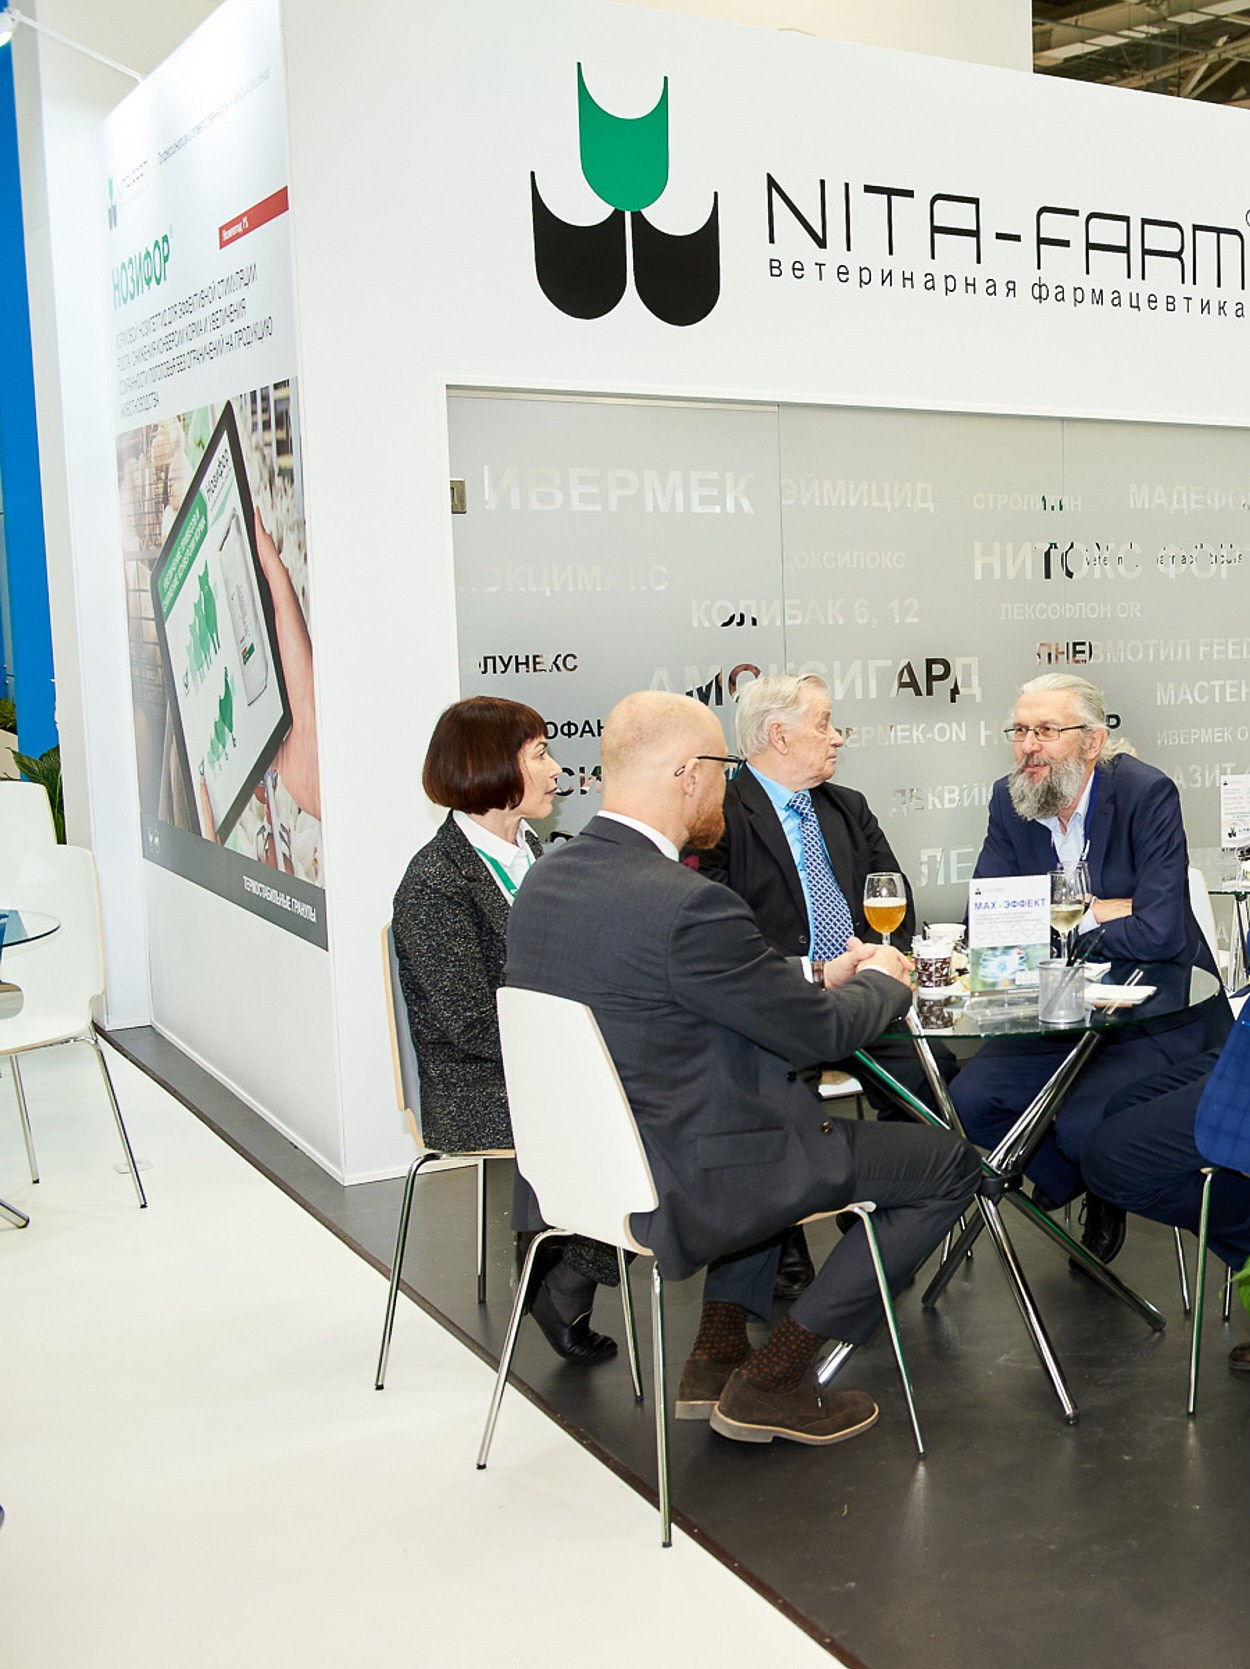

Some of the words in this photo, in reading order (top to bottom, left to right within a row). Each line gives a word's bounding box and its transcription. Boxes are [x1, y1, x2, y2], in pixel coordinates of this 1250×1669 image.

[112, 233, 170, 310] НОЗИФОР
[768, 256, 1018, 299] ветеринарная
[1031, 275, 1246, 319] фармацевтика
[483, 464, 755, 516] ИВЕРМЕК
[973, 541, 1144, 581] НИТОКС
[691, 598, 844, 629] КОЛИБАК
[889, 598, 919, 625] 12
[999, 601, 1112, 621] ЛЕКСОФЛОН
[1117, 600, 1142, 619] OR
[1036, 639, 1190, 665] ПНЕВМОТИЛ
[1156, 727, 1233, 747] ИВЕРМЕК
